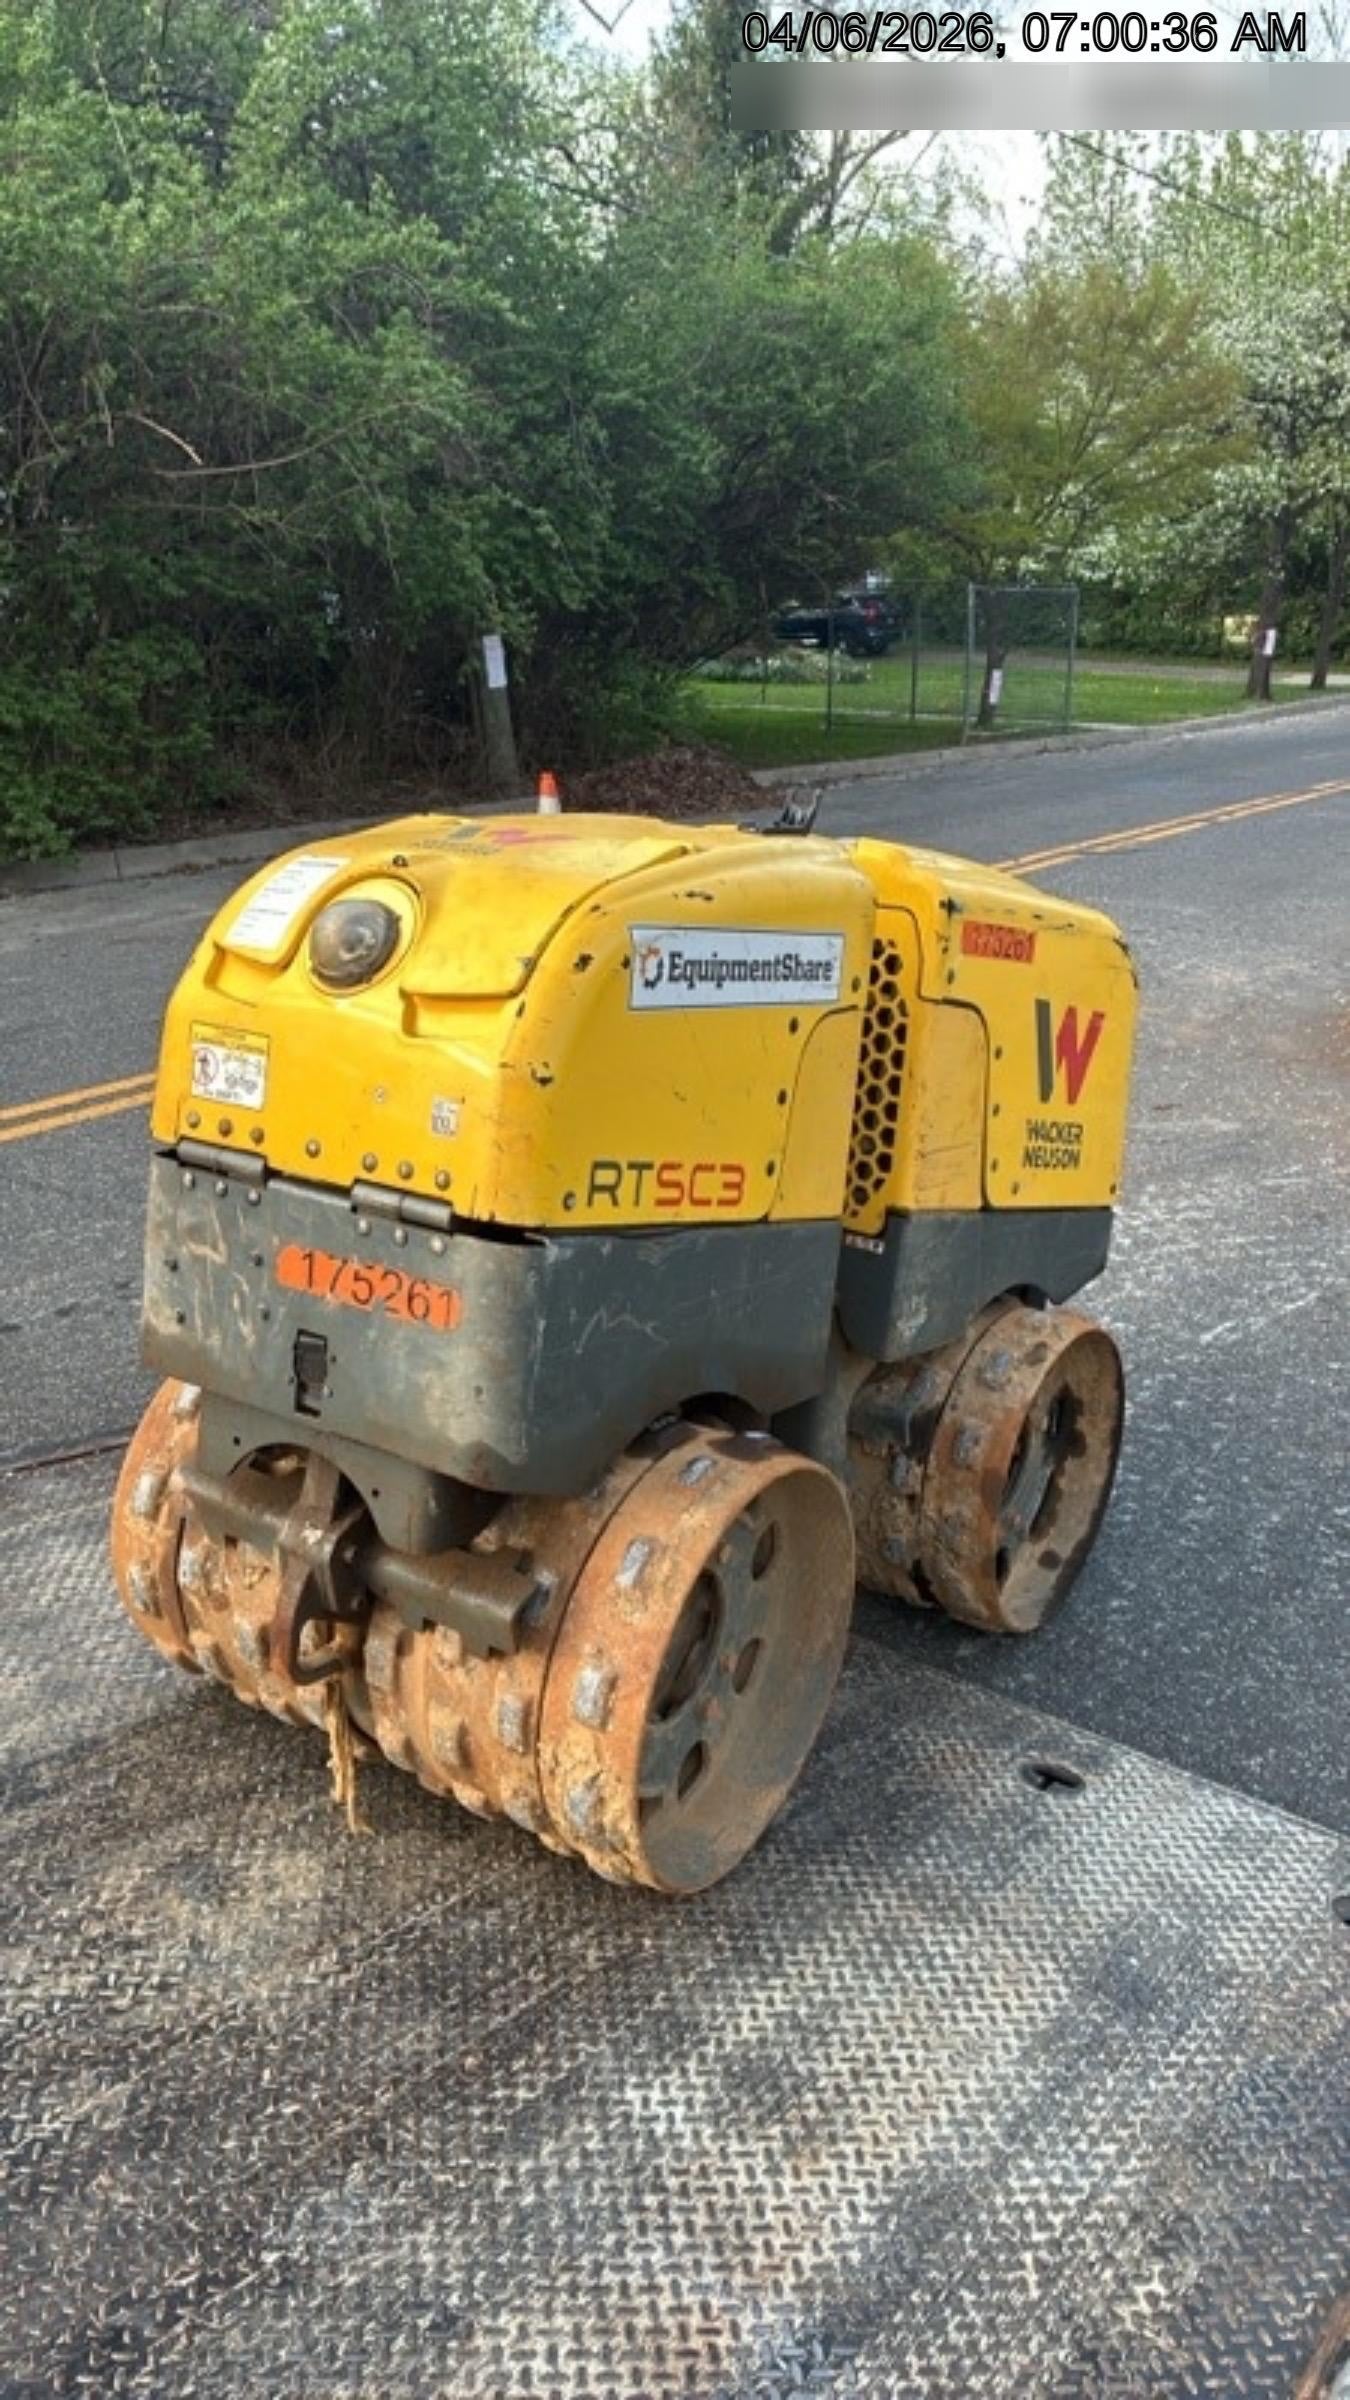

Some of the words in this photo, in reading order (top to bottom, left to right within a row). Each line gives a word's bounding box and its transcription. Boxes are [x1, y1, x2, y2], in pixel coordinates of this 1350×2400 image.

[667, 951, 833, 989] EquipmentShare
[1025, 1119, 1083, 1145] WACKER
[1022, 1146, 1081, 1170] NEUSON
[587, 1161, 745, 1207] RTSC3
[302, 1251, 452, 1328] 175261
